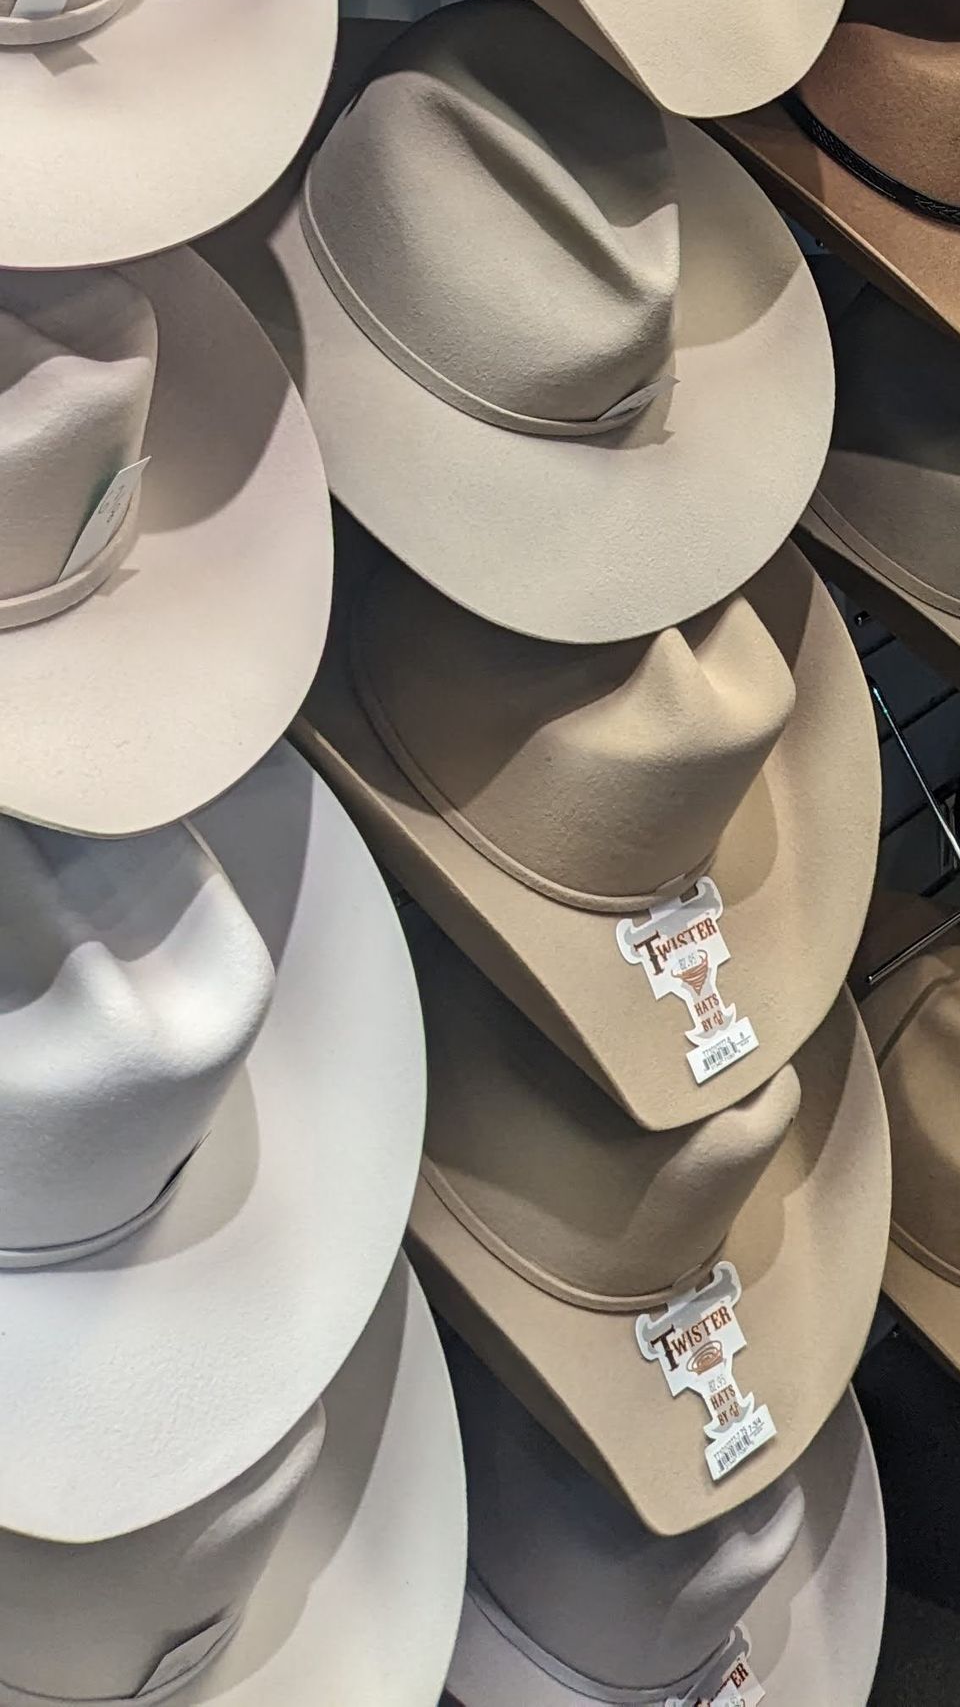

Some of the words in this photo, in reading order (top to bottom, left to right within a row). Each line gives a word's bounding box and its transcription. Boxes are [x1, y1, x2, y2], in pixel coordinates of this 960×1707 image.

[633, 917, 718, 976] TWISTER
[694, 993, 720, 1016] HATS
[701, 1018, 713, 1032] BY
[651, 1305, 732, 1372] TWISTER
[710, 1384, 736, 1410] HATS
[718, 1410, 729, 1426] BY
